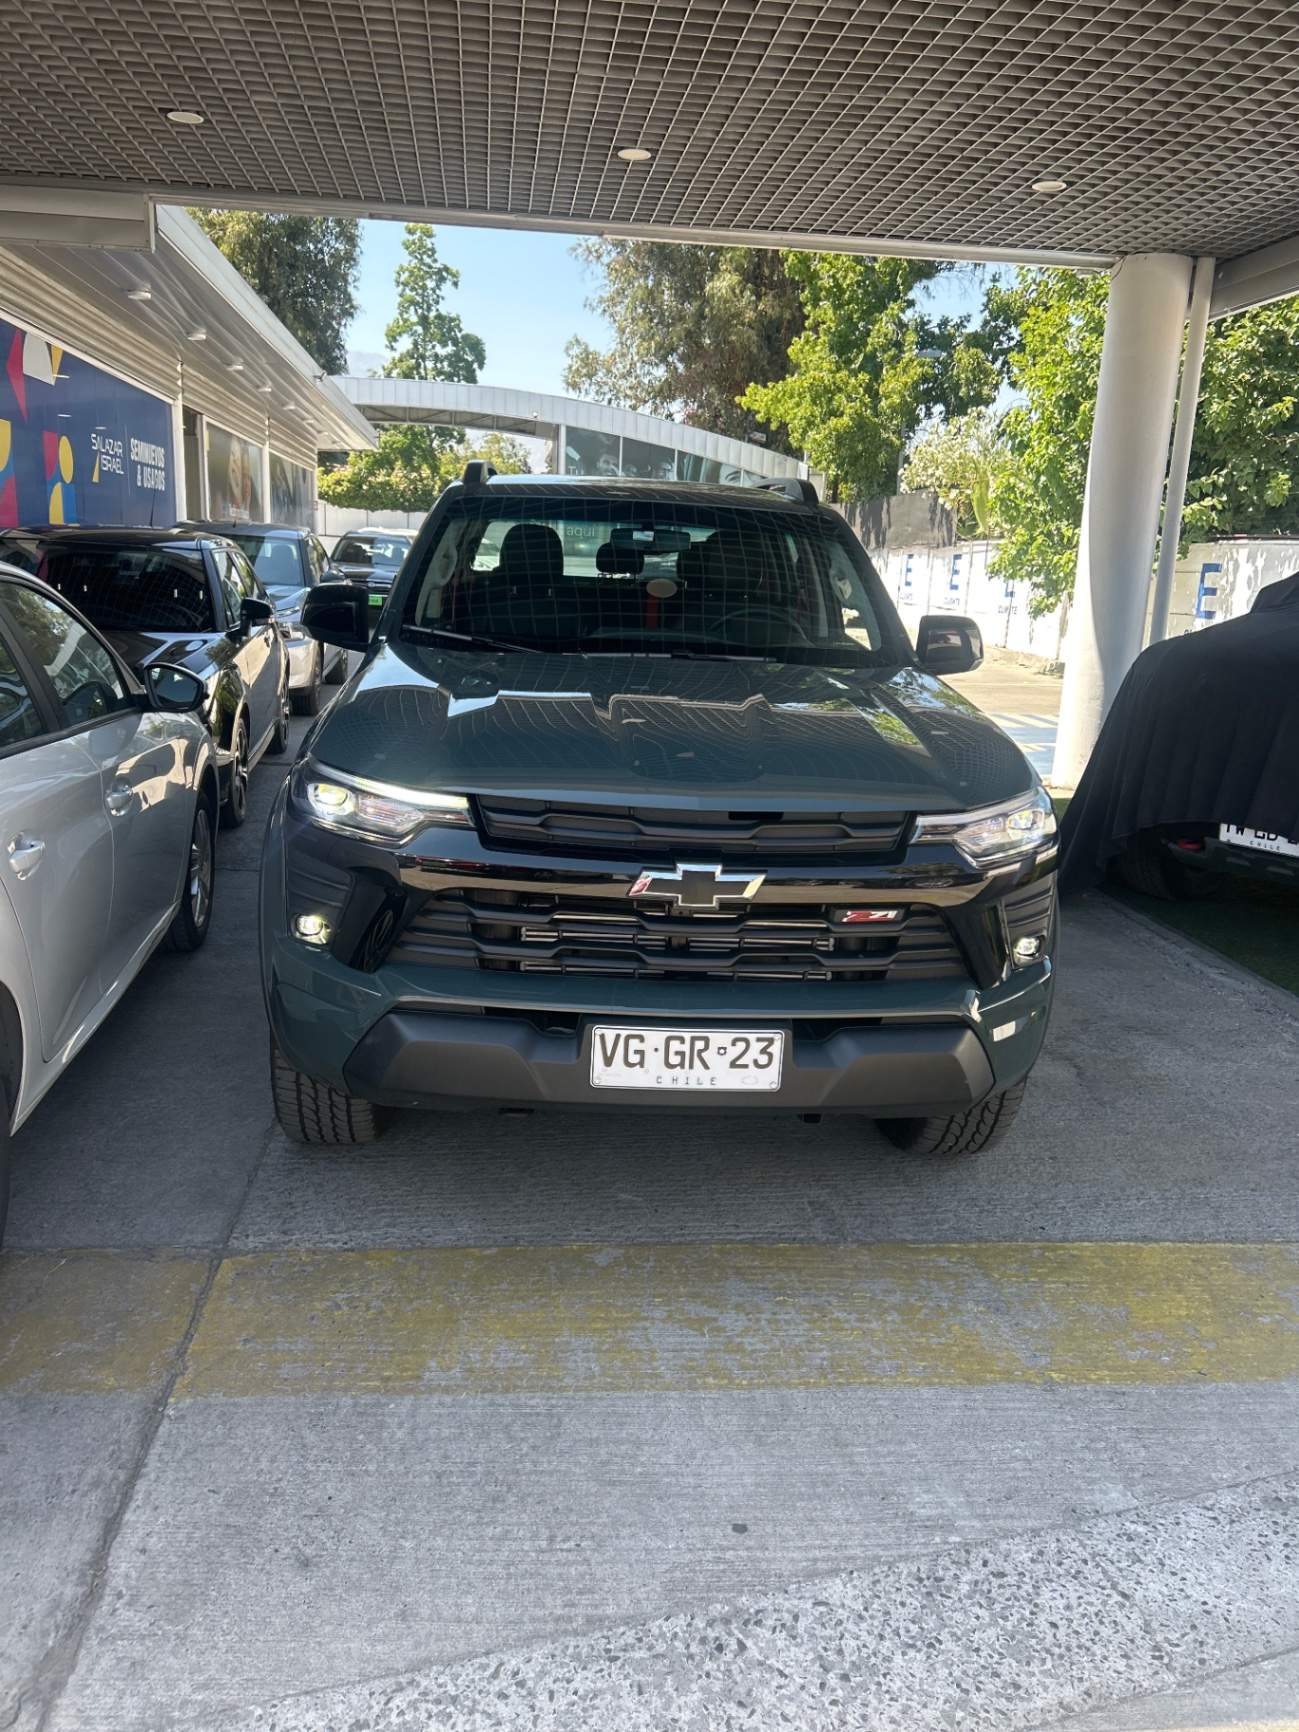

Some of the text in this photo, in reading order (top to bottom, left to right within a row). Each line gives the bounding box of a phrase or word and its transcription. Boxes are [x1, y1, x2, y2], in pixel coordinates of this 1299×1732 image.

[91, 433, 123, 457] SALAZAR
[130, 437, 165, 469] SEMINUEVOS
[101, 455, 125, 475] ISRAEL
[143, 466, 165, 491] USADOS
[1195, 563, 1222, 620] E
[656, 1075, 717, 1086] CHILE
